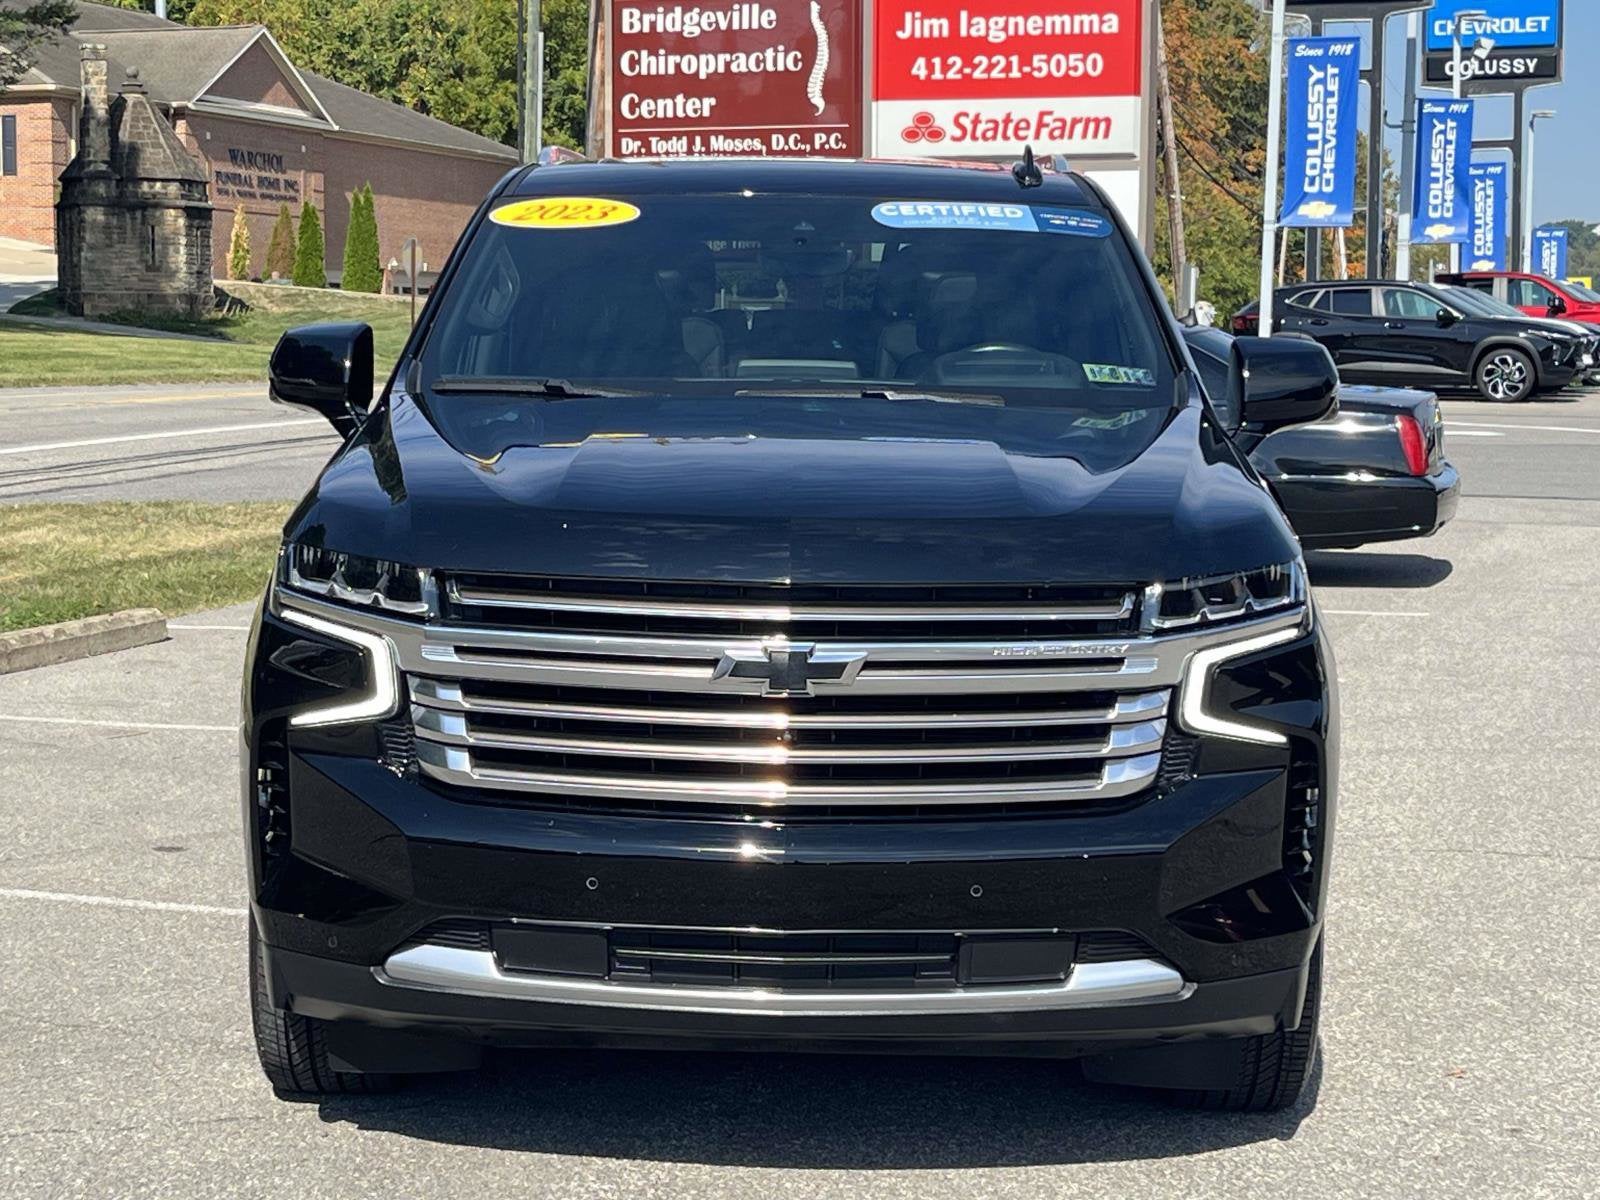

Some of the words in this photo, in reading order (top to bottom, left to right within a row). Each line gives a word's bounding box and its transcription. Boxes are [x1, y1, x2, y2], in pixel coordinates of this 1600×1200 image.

[622, 4, 776, 38] Bridgeville
[895, 11, 949, 40] Jim
[959, 10, 1119, 43] Iagnemma
[1433, 15, 1551, 36] CHEVROLET
[620, 45, 803, 79] Chiropractic
[1294, 44, 1324, 57] Since
[1327, 43, 1354, 57] 1918
[911, 52, 1104, 81] 412-221-5050
[1444, 58, 1538, 77] COLUSSY
[620, 92, 717, 119] Center
[1303, 64, 1325, 193] COLUSSY
[1321, 63, 1340, 193] CHEVROLET
[621, 137, 646, 154] Dr.
[649, 136, 687, 154] Todd
[692, 136, 706, 153] J.
[710, 134, 767, 157] Moses,
[814, 132, 847, 150] P.C.
[228, 148, 286, 174] WARCHOL
[1429, 118, 1446, 219] COLUSSY
[1442, 118, 1457, 218] CHEVROLET
[512, 205, 618, 221] 2023
[879, 204, 1024, 219] CERTIFIED
[1474, 178, 1486, 256] COLUSSY
